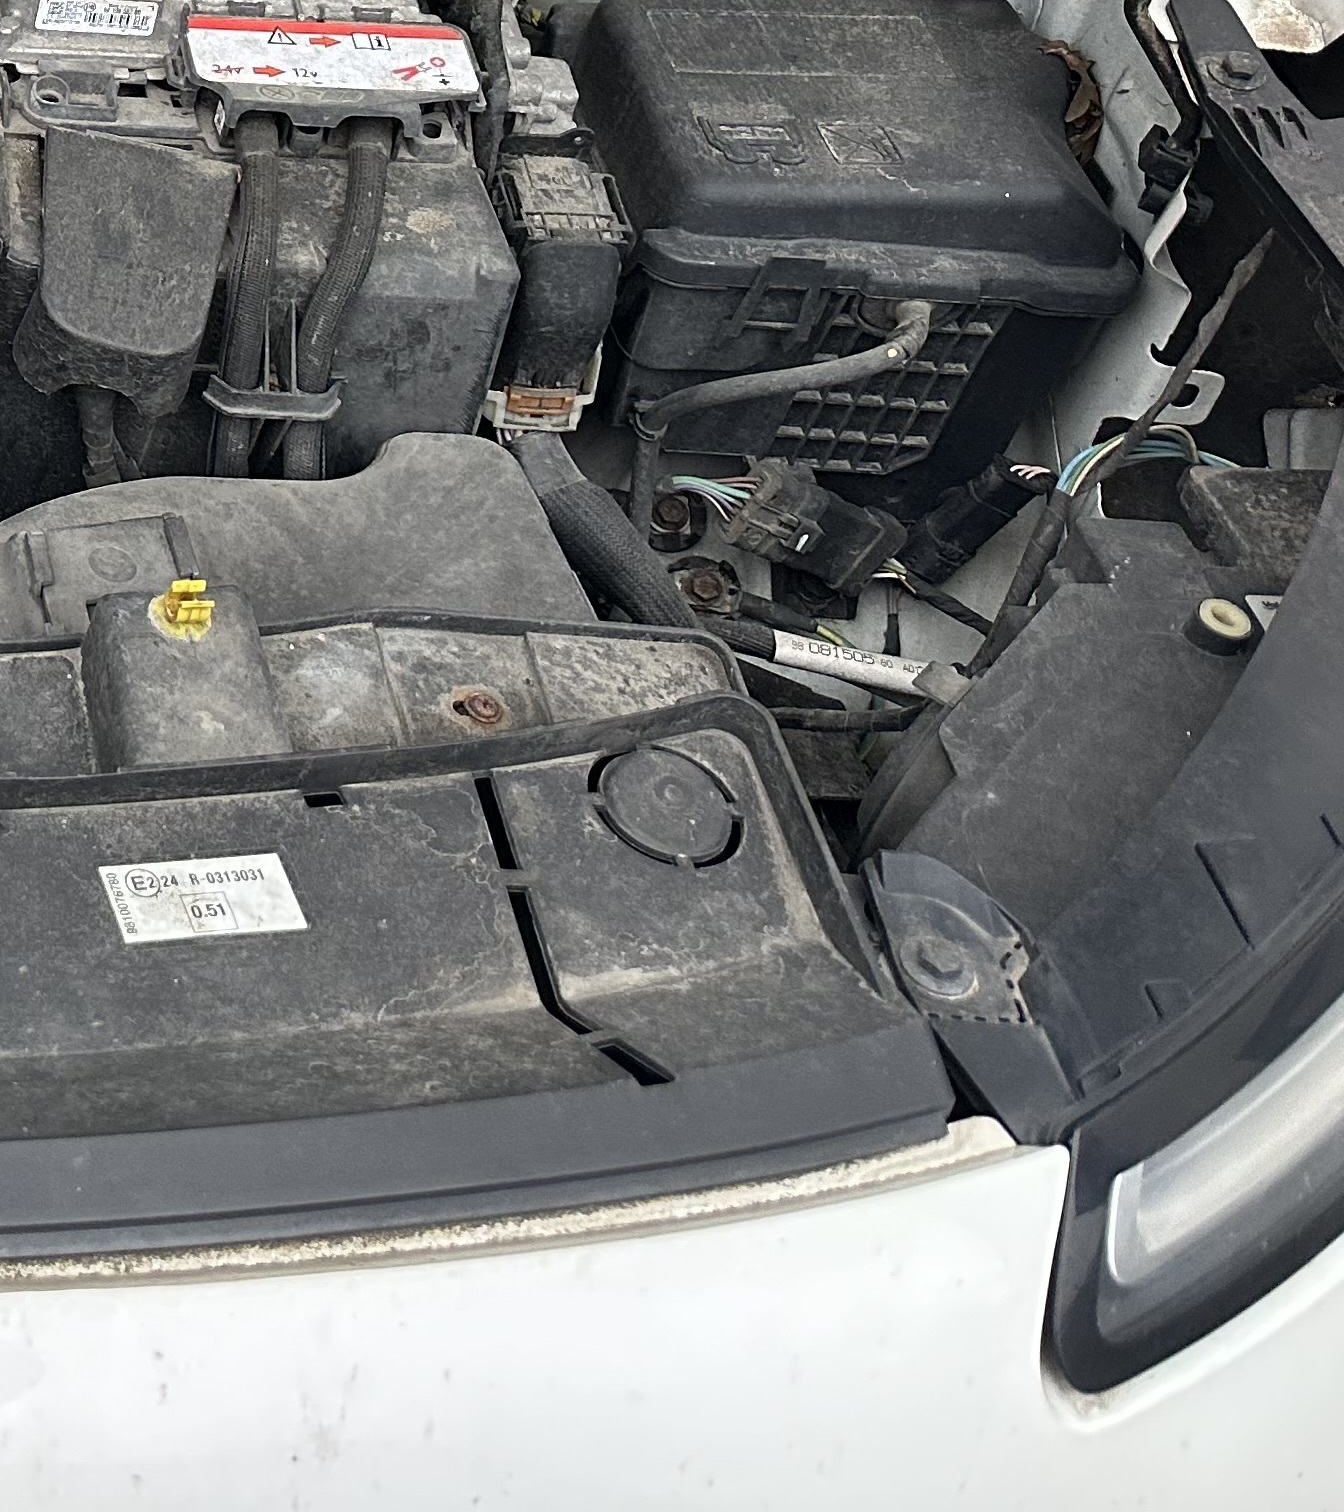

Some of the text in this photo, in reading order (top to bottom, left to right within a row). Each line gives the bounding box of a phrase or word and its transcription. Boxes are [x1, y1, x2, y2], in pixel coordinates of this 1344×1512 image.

[809, 642, 874, 665] 081505
[189, 868, 265, 886] R-0313031
[191, 903, 227, 919] 0.51
